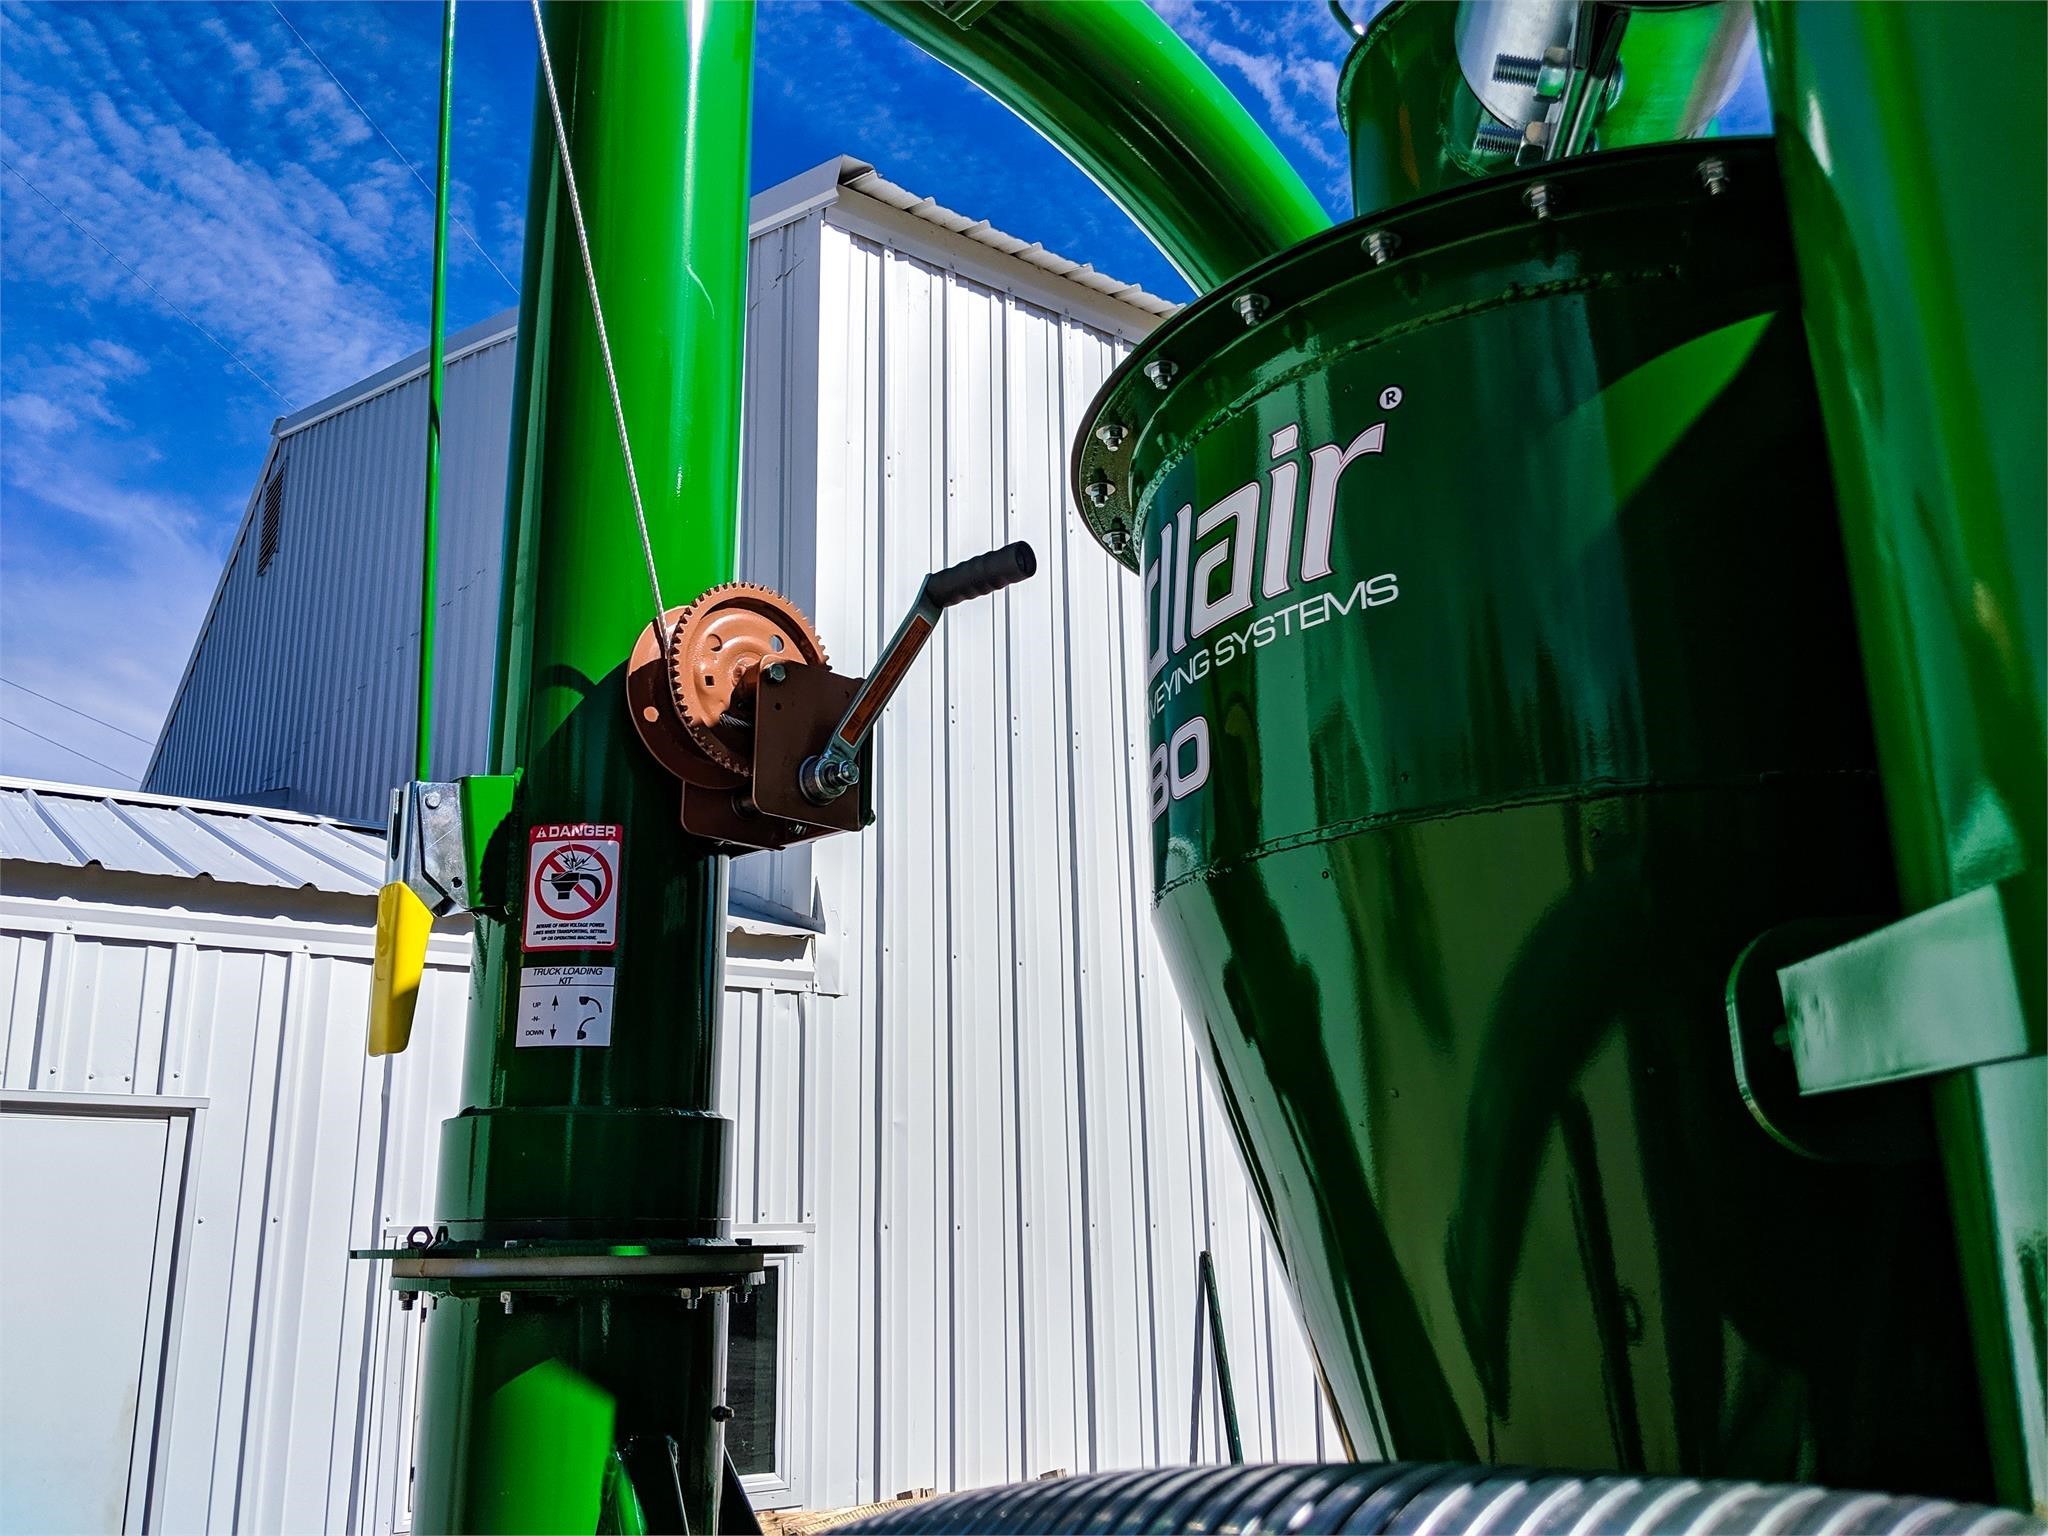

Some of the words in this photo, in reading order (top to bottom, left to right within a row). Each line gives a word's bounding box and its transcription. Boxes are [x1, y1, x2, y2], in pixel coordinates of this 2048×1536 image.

[1214, 573, 1400, 667] SYSTEMS
[548, 825, 616, 838] DANGER
[533, 967, 561, 976] TRUCK
[562, 967, 603, 976] LOADING
[558, 977, 574, 985] KIT
